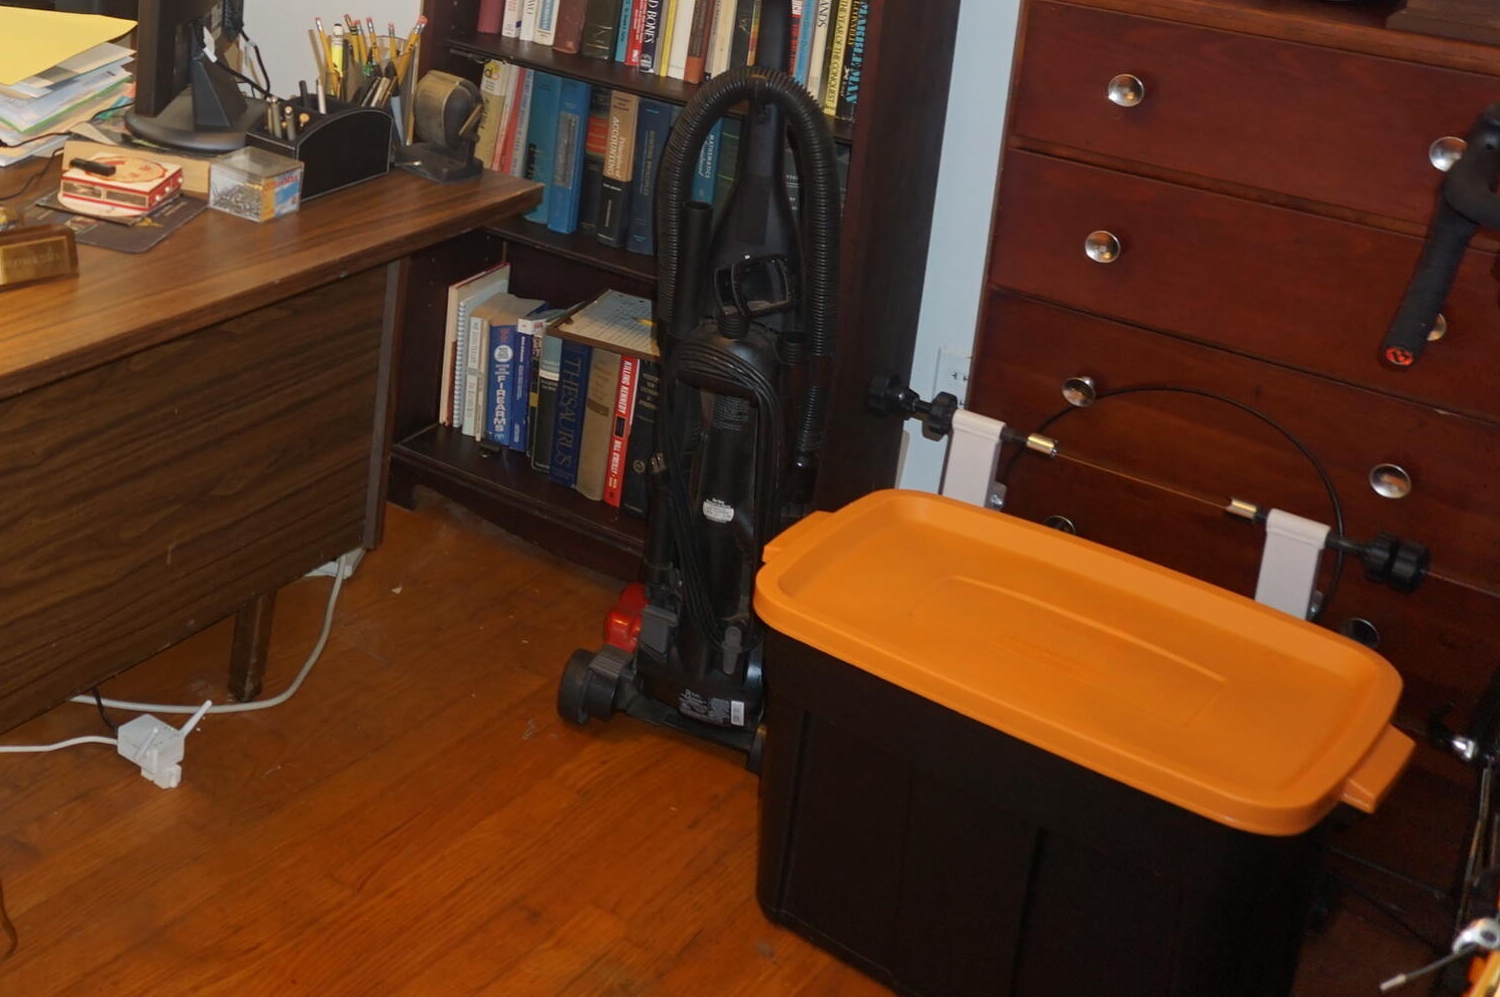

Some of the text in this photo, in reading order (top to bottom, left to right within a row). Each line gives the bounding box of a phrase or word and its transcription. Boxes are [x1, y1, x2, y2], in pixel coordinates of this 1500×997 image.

[644, 10, 657, 44] BONES
[837, 15, 847, 35] YEAR
[850, 3, 869, 67] MARBLE
[833, 47, 842, 62] THE
[828, 62, 840, 103] CONQUEST
[845, 70, 860, 103] MAN
[606, 116, 620, 176] ACCOUNTING
[705, 134, 715, 179] MATHEMATICS
[493, 375, 506, 432] FIREARMS
[617, 361, 632, 414] KILLING KENNEDY
[556, 358, 581, 467] THESAURUS
